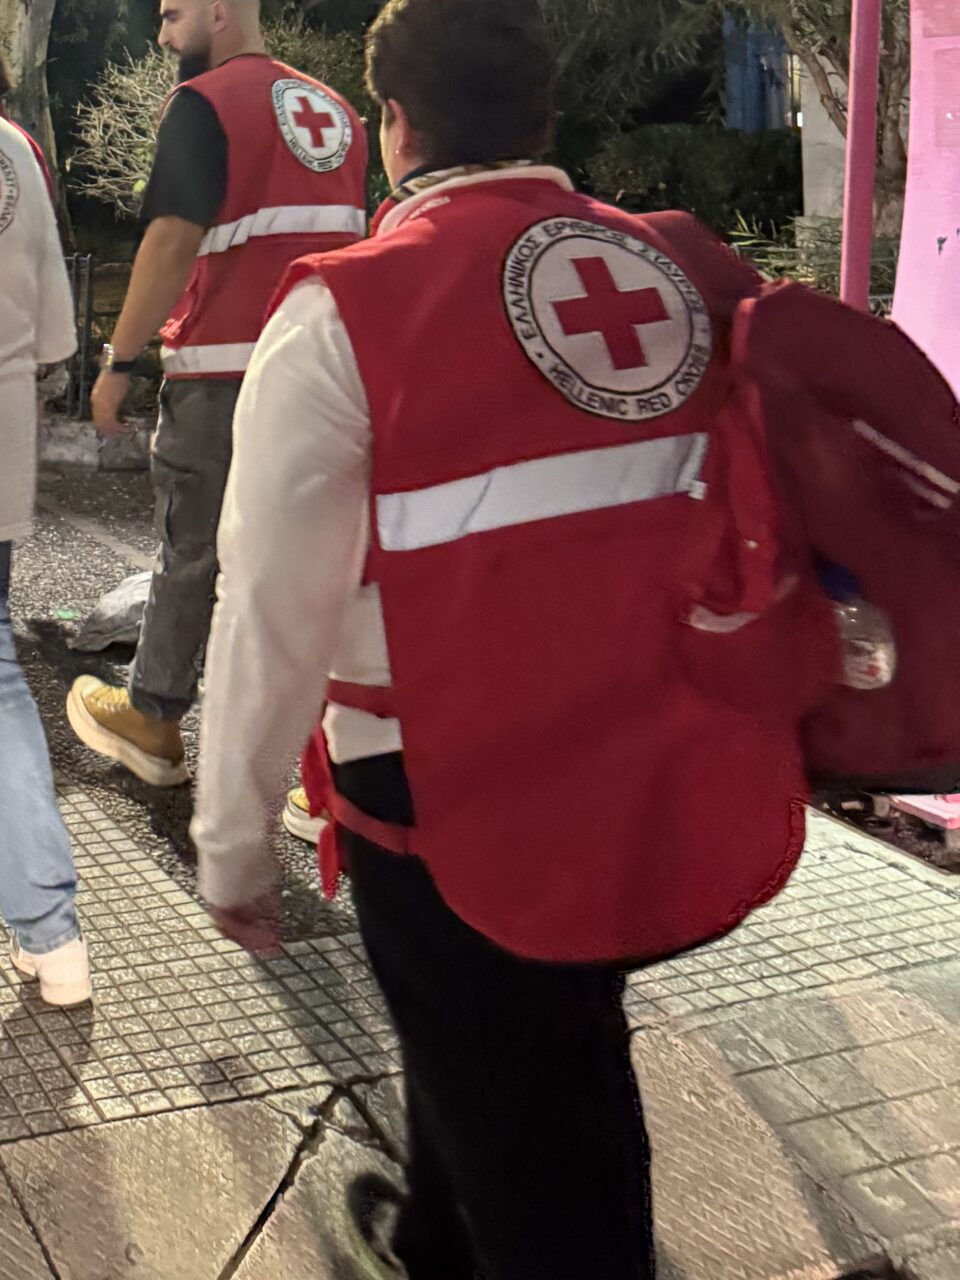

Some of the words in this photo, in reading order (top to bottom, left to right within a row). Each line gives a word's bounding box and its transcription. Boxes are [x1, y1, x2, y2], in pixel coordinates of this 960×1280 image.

[506, 235, 542, 340] ΕΛΛΗΝΙΚΟΣ
[548, 361, 629, 416] HELLENIC
[637, 393, 673, 415] RED
